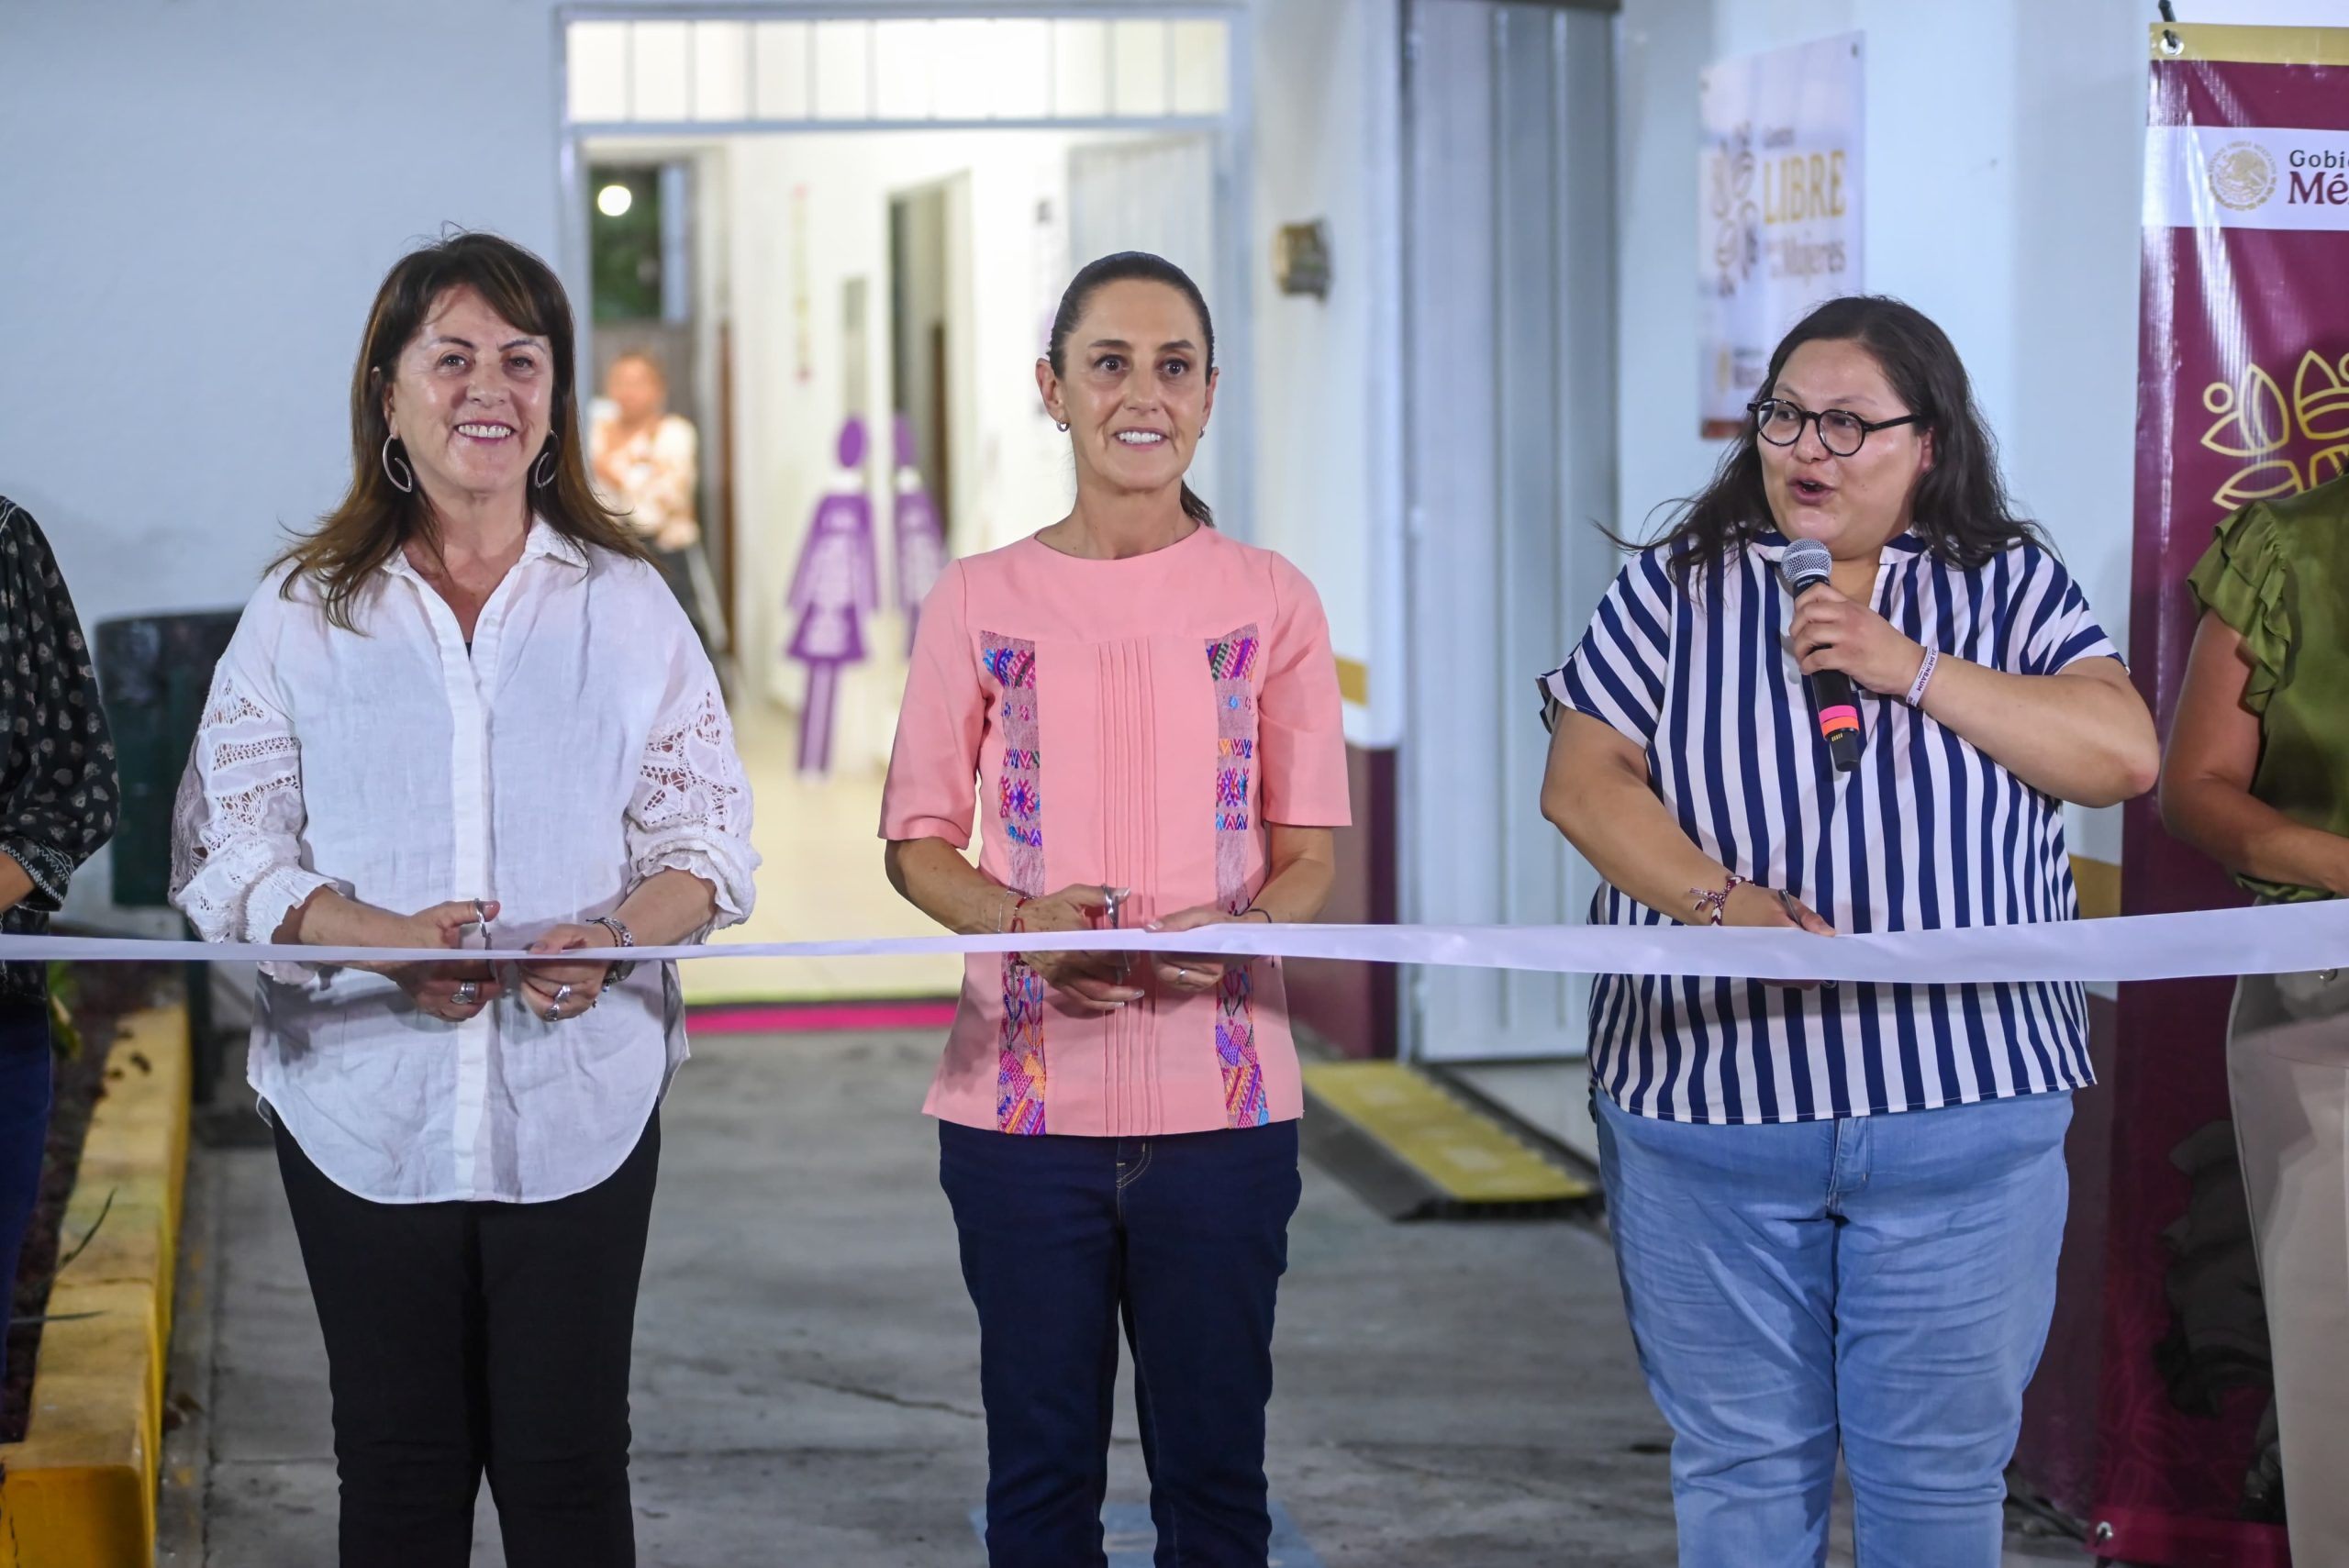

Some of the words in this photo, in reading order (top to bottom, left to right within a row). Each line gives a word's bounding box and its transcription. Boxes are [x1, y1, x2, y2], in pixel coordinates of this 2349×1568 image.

[2289, 150, 2349, 168] Gobi
[1764, 149, 1846, 224] LIBRE
[2288, 171, 2349, 206] Mé
